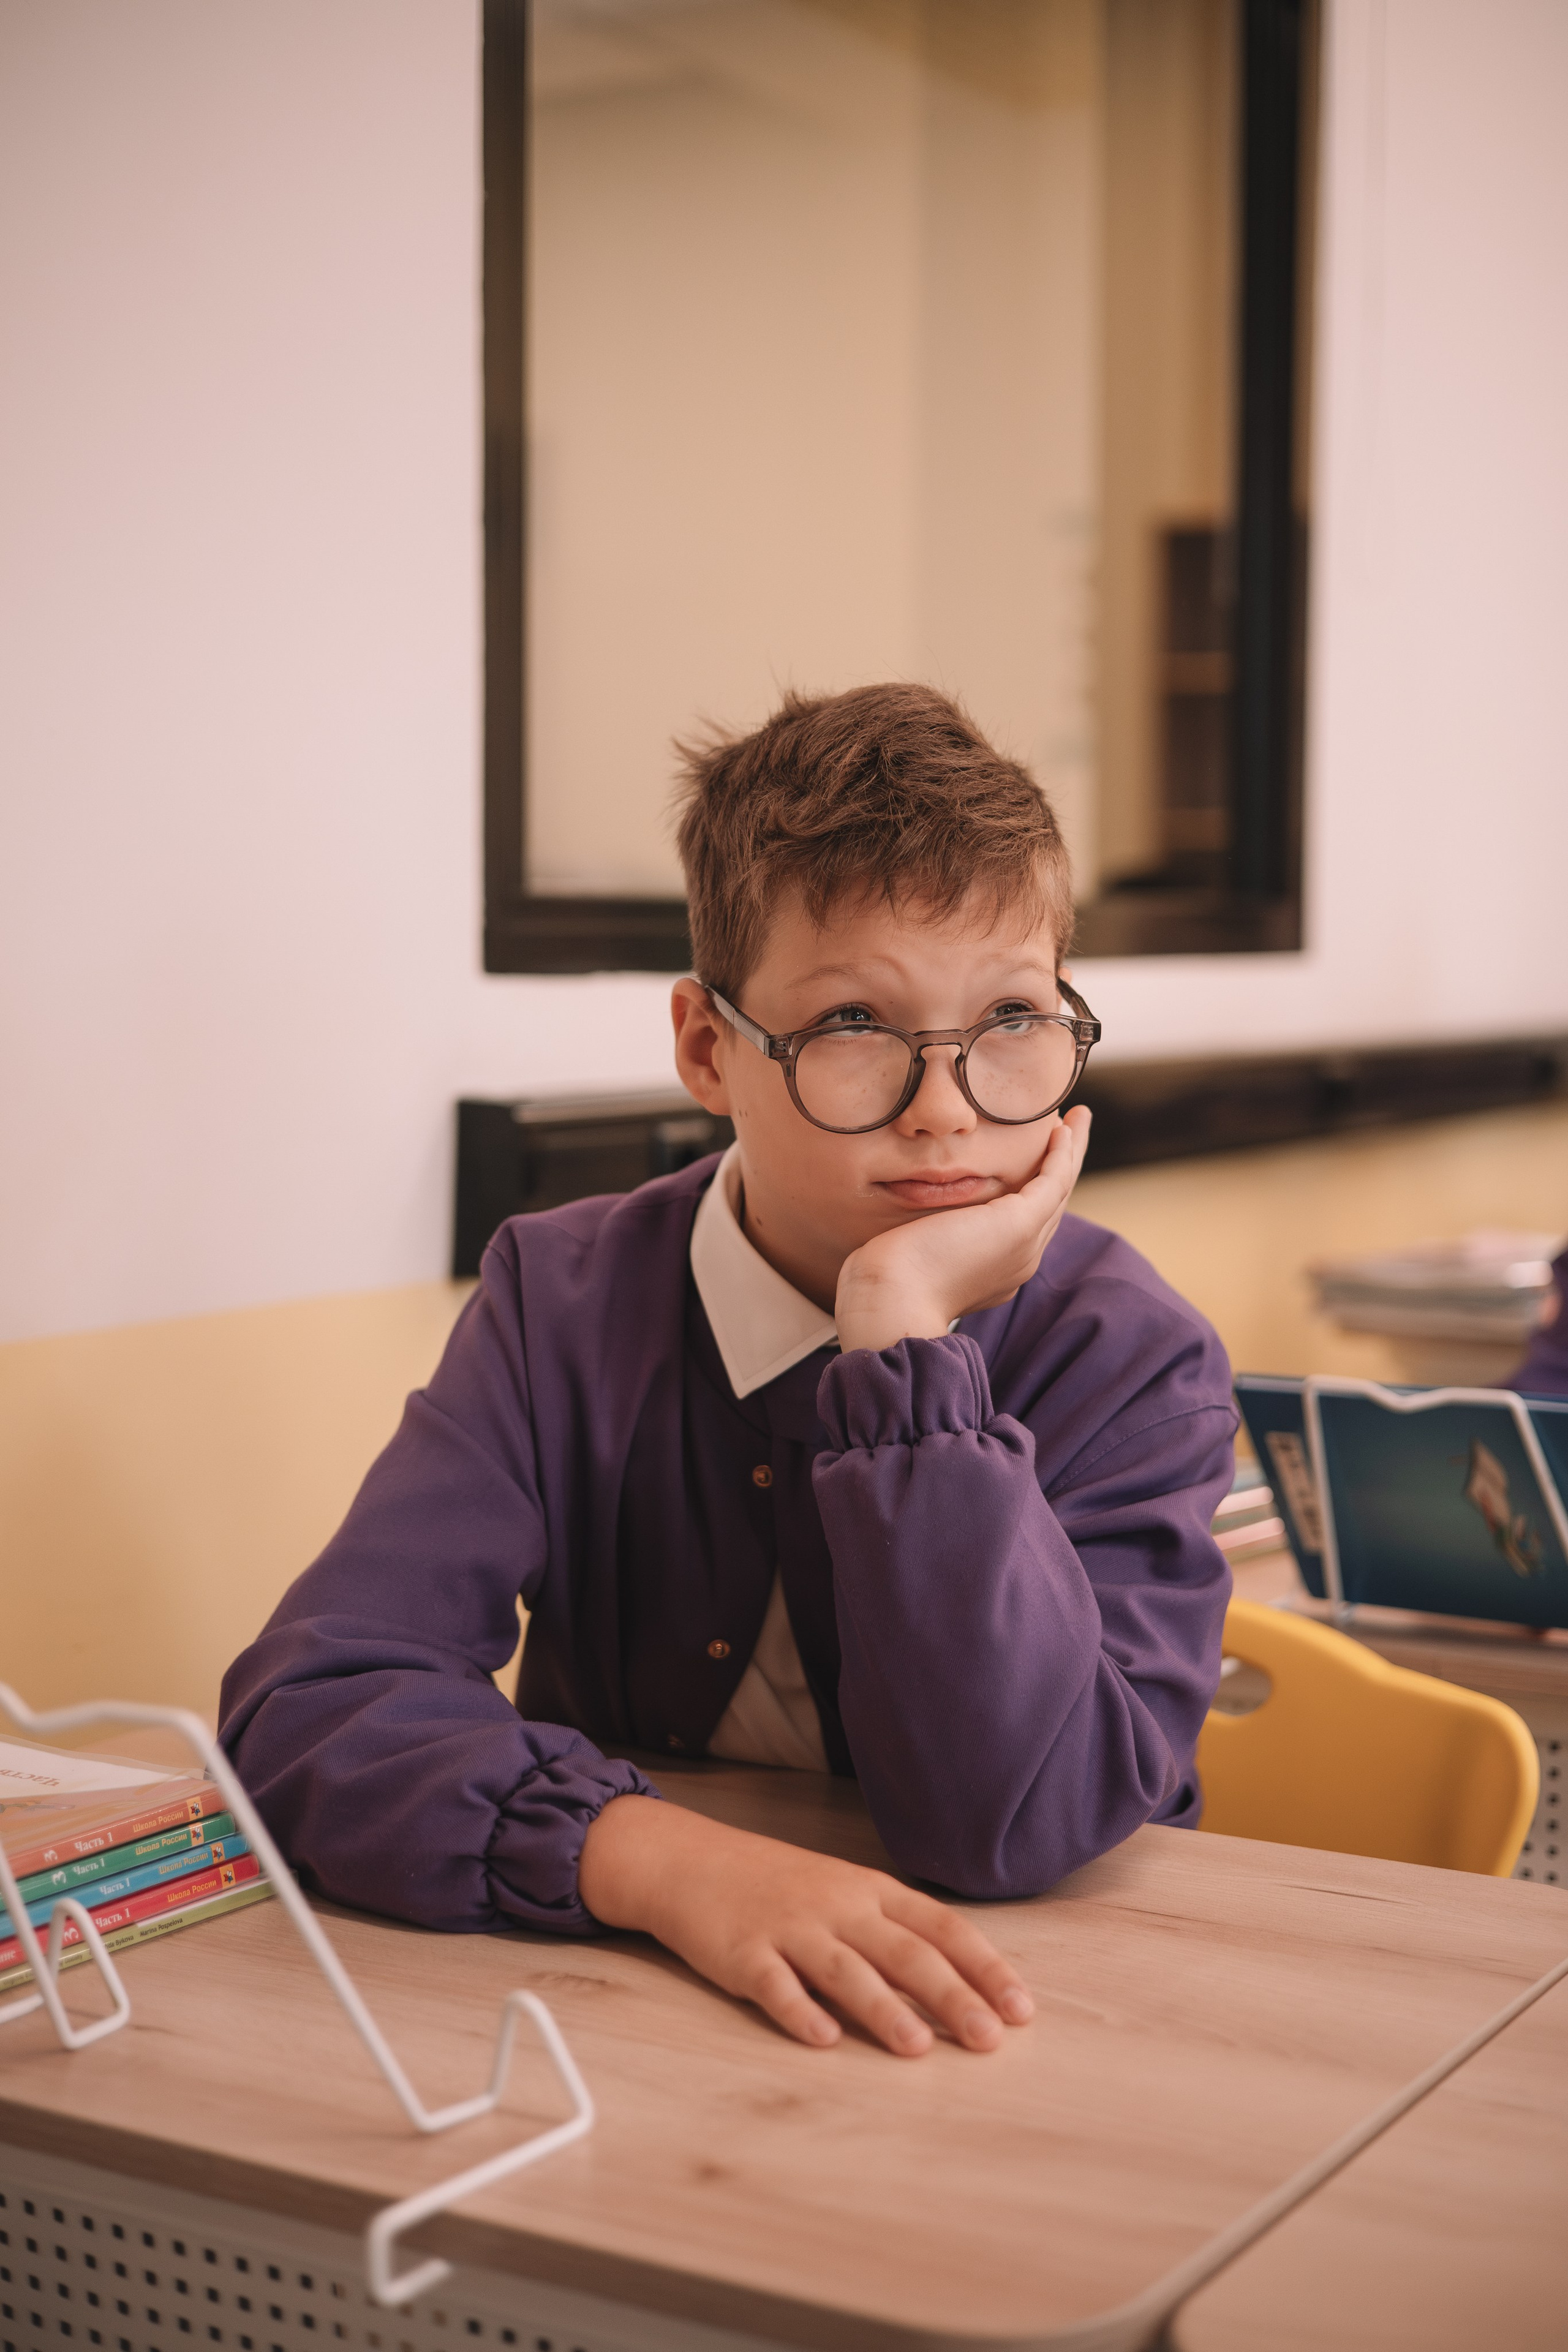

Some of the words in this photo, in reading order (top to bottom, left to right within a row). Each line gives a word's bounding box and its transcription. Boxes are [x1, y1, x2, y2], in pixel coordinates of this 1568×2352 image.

[133, 1821, 157, 1833] Школа
[158, 1811, 184, 1824] России
[74, 1838, 104, 1852] Часть
[107, 1832, 113, 1842] 1
[135, 1843, 160, 1855] Школа
[161, 1833, 187, 1846] России
[72, 1863, 99, 1875] Часть
[100, 1858, 105, 1867] 1
[159, 1863, 183, 1874] Школа
[183, 1852, 208, 1866] России
[99, 1883, 124, 1895] Часть
[126, 1878, 130, 1887] 1
[167, 1890, 190, 1902] Школа
[192, 1880, 217, 1893] России
[95, 1914, 122, 1928] Часть
[125, 1908, 130, 1918] 1
[115, 1935, 134, 1947] Bykova
[140, 1927, 157, 1937] Marina
[158, 1917, 183, 1931] Pospelova
